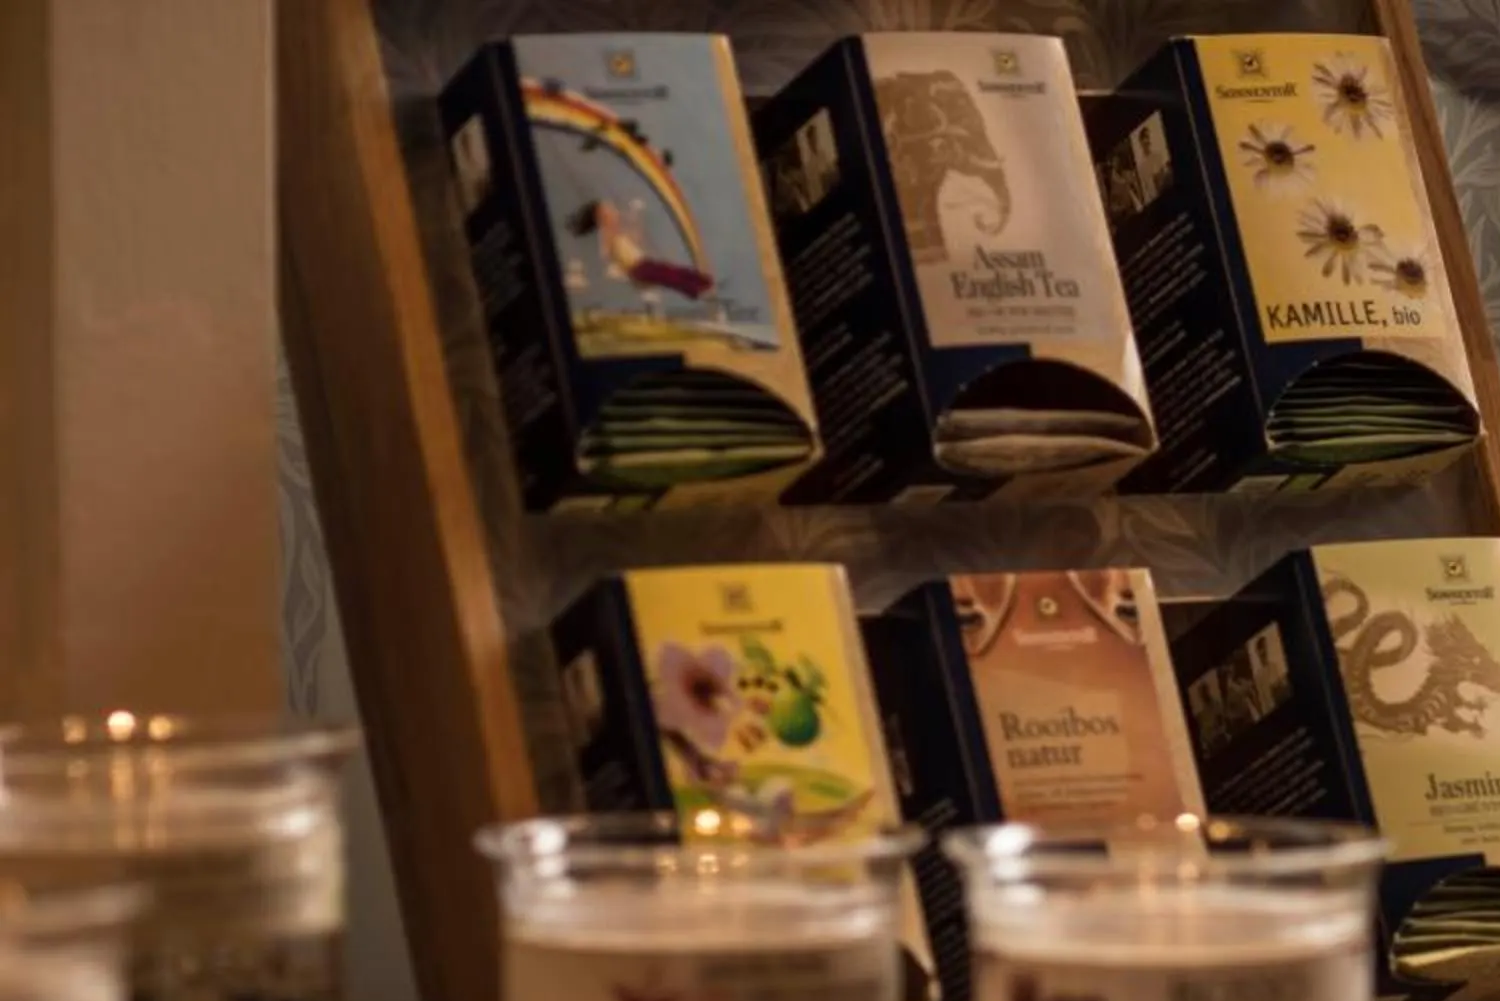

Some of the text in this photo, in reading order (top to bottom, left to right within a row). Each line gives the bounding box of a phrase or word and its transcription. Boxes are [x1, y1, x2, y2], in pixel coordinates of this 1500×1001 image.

[973, 243, 1046, 270] Assam
[951, 270, 1081, 304] English Tea
[1266, 300, 1421, 330] KAMILLE, bio
[999, 705, 1120, 741] Rooibos
[1006, 744, 1083, 769] natur
